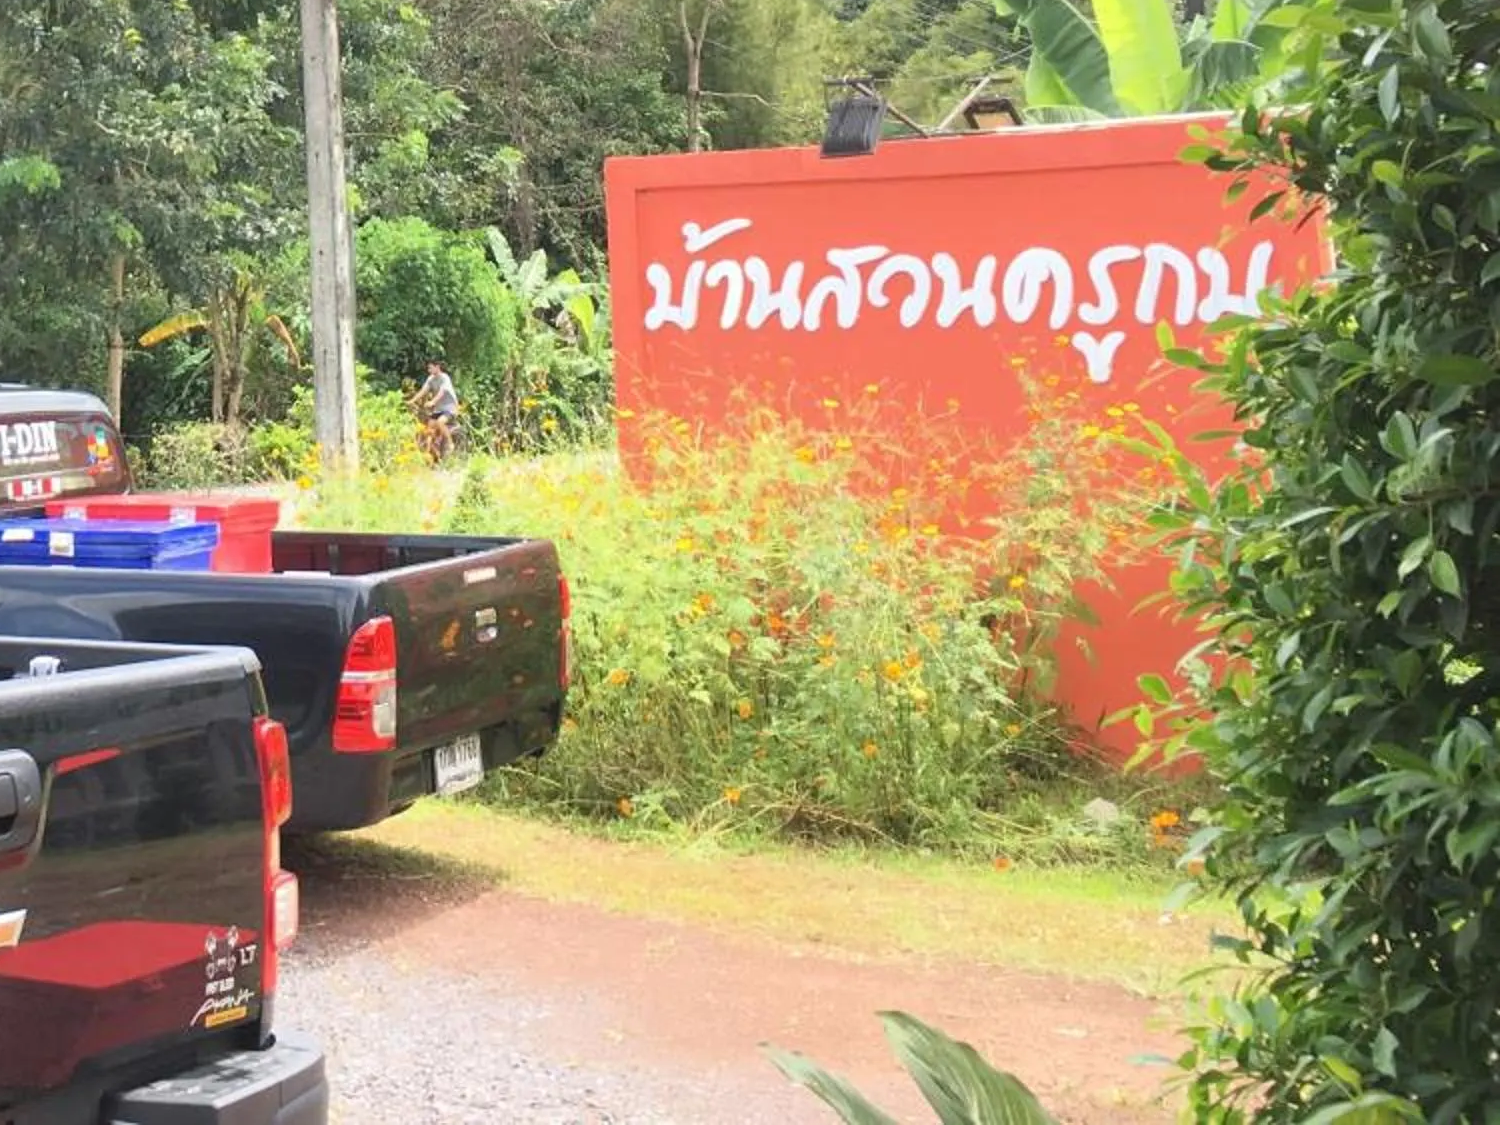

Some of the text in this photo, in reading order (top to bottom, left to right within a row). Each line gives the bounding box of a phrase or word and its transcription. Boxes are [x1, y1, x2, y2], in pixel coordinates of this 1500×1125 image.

[645, 218, 1274, 383] บ้านสวนครูกบ
